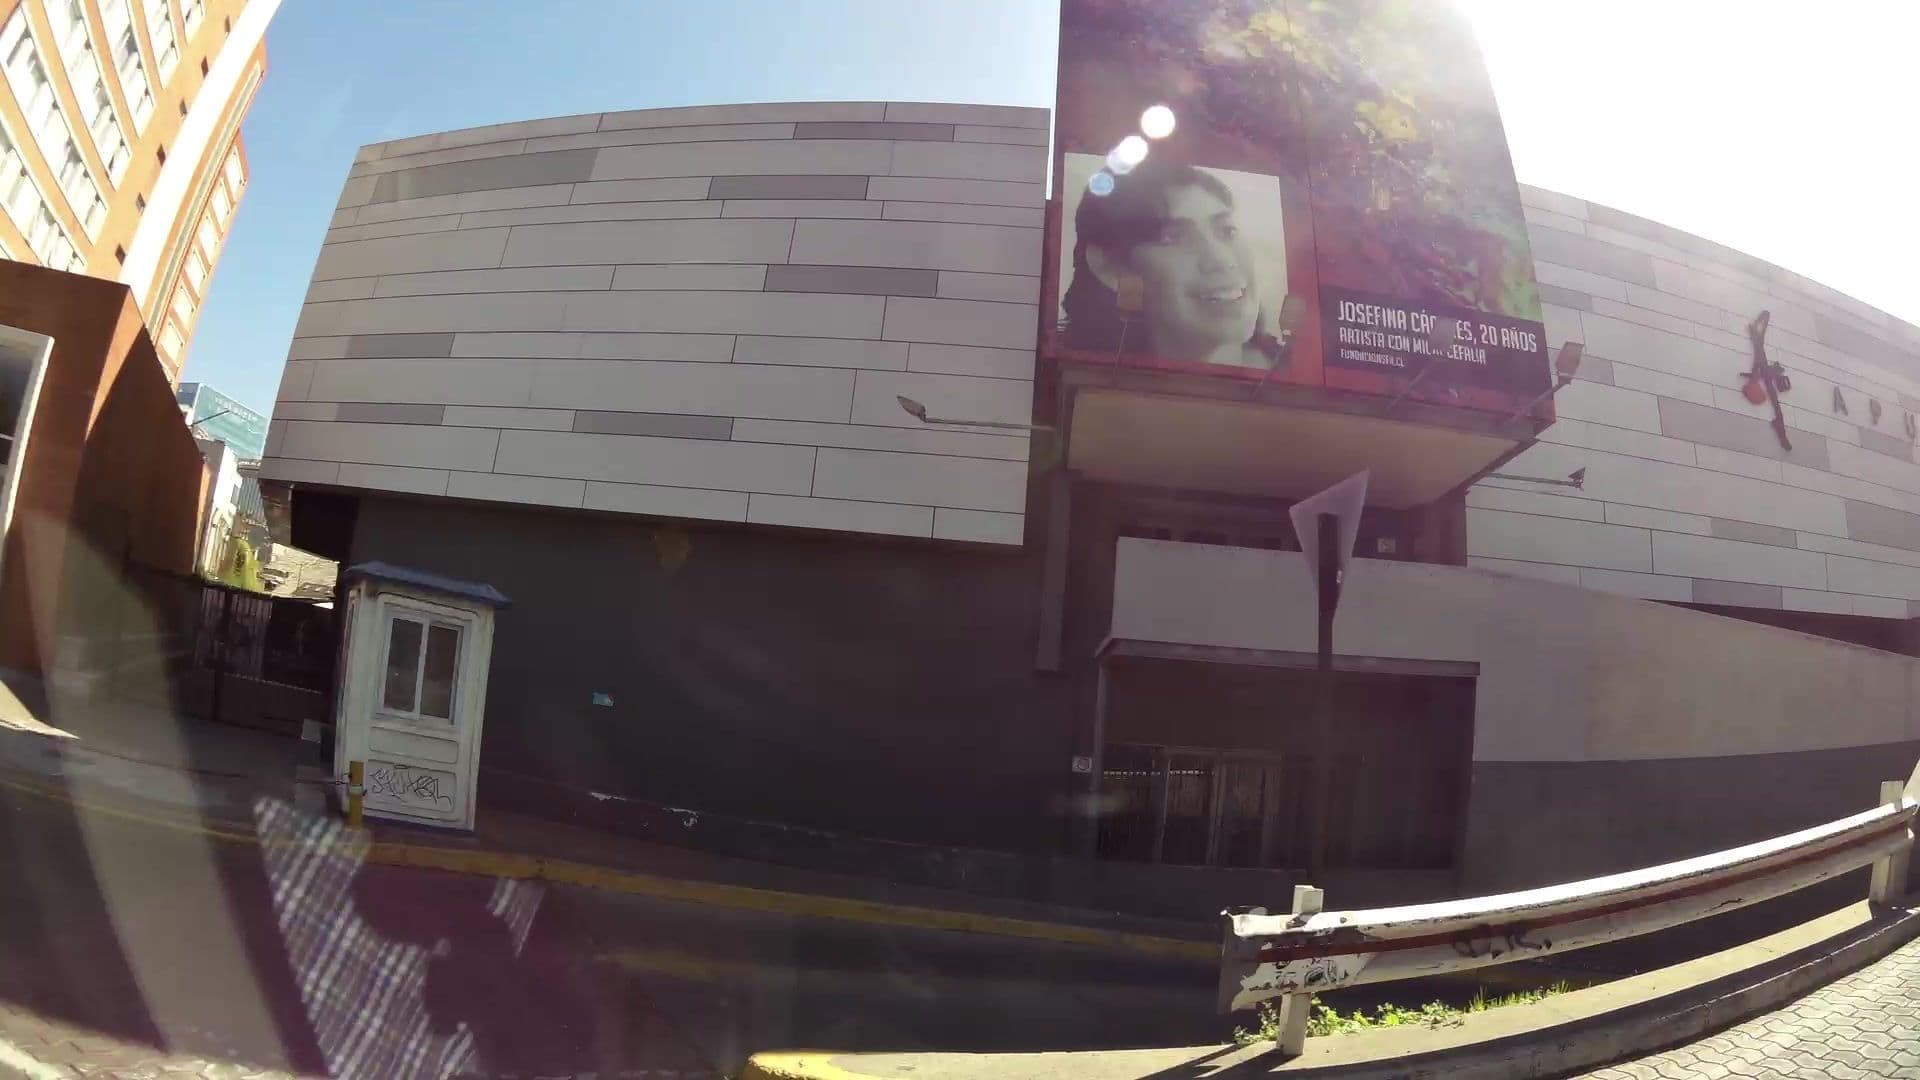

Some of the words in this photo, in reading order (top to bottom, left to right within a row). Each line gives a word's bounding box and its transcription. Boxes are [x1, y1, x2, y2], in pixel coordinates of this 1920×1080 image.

[1338, 300, 1407, 331] JOSEFINA
[1479, 324, 1498, 346] 20
[1501, 327, 1537, 353] AÑOS
[1339, 326, 1385, 349] ARTISTA
[1387, 334, 1410, 353] CON
